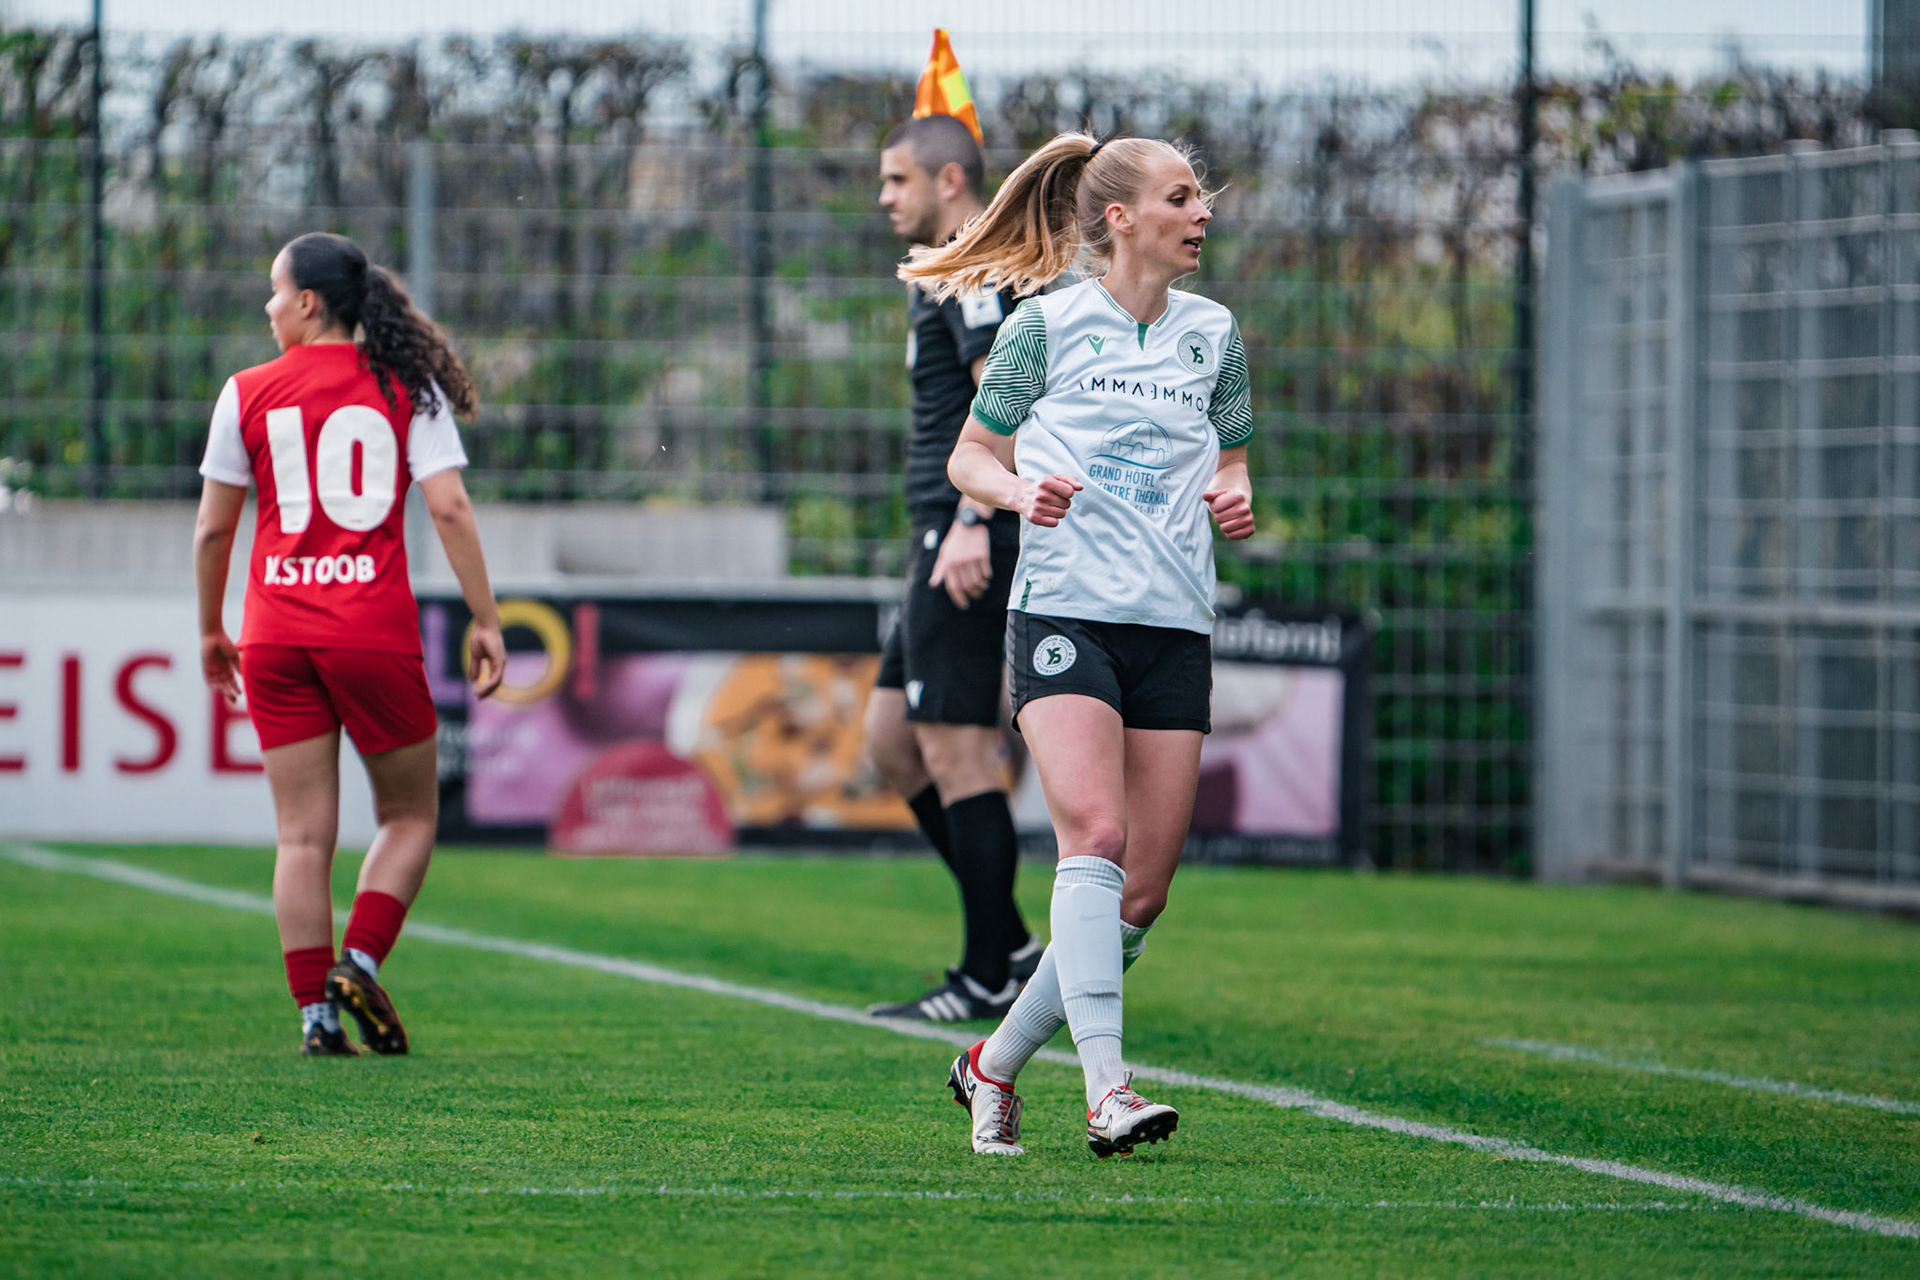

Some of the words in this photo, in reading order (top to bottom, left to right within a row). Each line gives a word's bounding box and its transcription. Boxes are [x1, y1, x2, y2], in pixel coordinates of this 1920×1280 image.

[266, 404, 398, 534] 10
[1089, 464, 1122, 481] GRAND
[1125, 468, 1155, 488] HÔTEL
[1097, 482, 1131, 501] ENTRE
